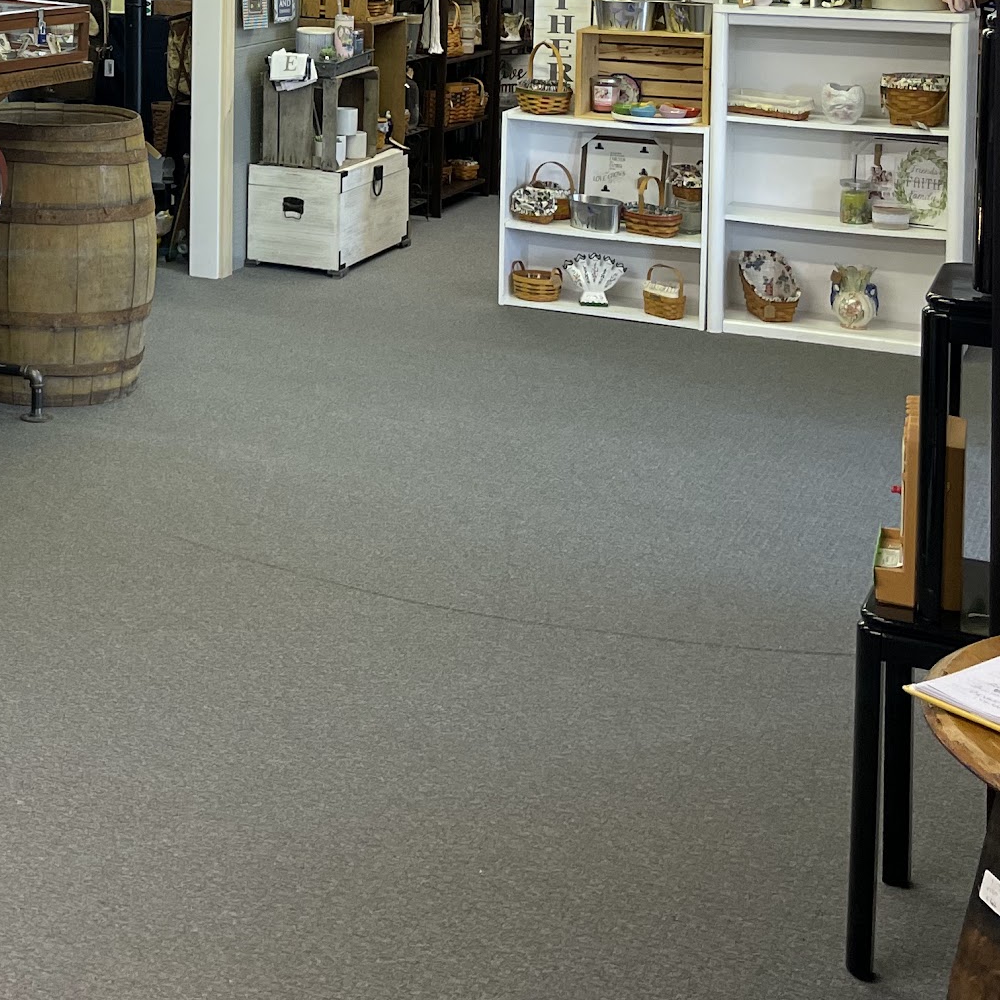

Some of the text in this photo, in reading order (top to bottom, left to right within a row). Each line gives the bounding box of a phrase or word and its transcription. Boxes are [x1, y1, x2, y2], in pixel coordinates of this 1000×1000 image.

[279, 0, 291, 7] AND
[284, 56, 297, 71] E
[905, 176, 943, 190] FAITH
